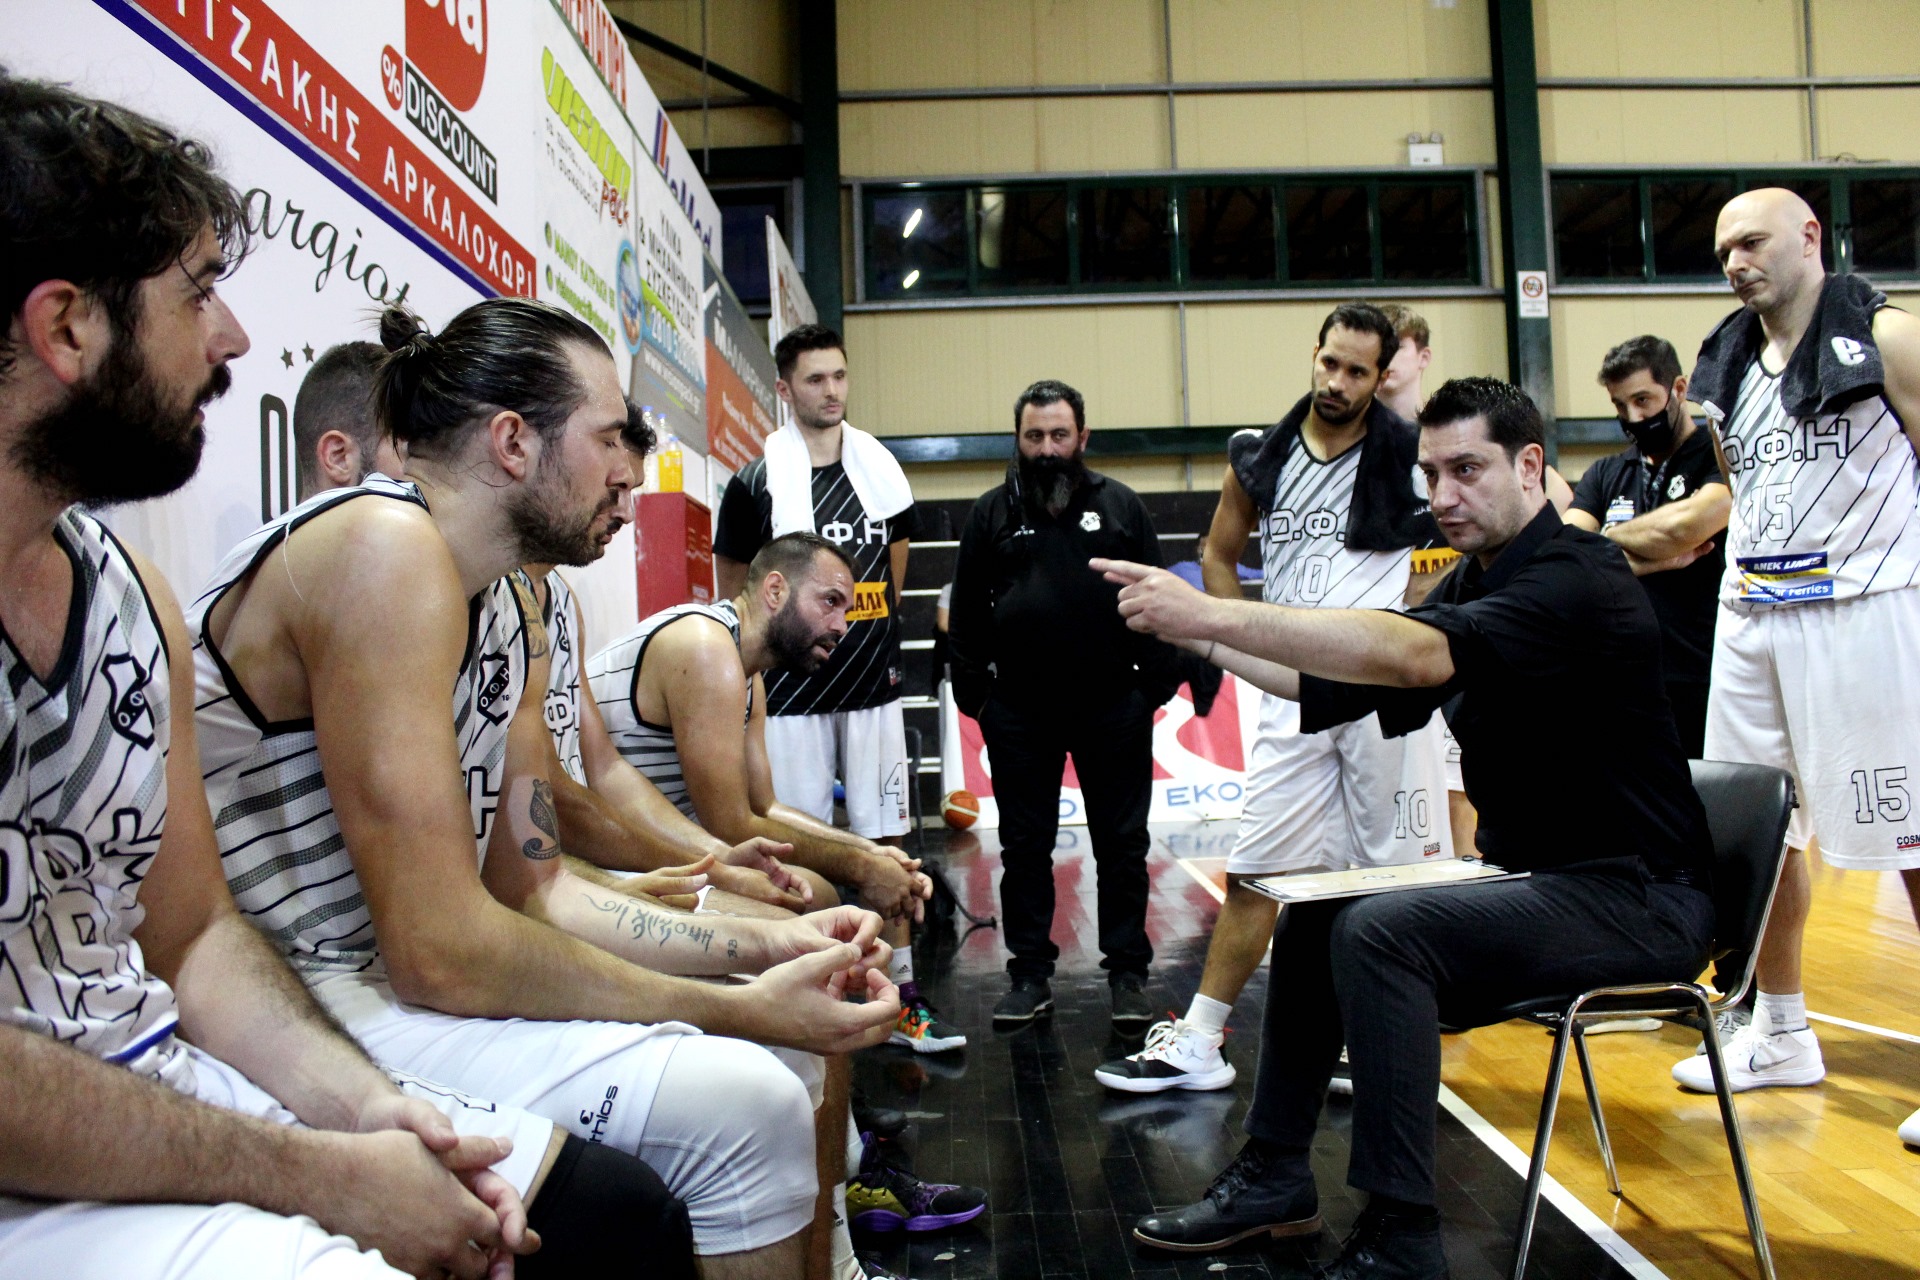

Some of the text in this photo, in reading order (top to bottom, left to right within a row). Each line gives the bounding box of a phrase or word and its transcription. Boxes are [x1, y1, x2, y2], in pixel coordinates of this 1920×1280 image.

[406, 71, 497, 196] DISCOUNT
[383, 146, 534, 298] ΑΡΚΑΛΟΧΩΡΙ
[1750, 481, 1795, 544] 15
[1753, 556, 1823, 571] ANEK LINES
[1166, 781, 1243, 807] EKO
[1394, 788, 1430, 839] 10
[1850, 765, 1911, 823] 15
